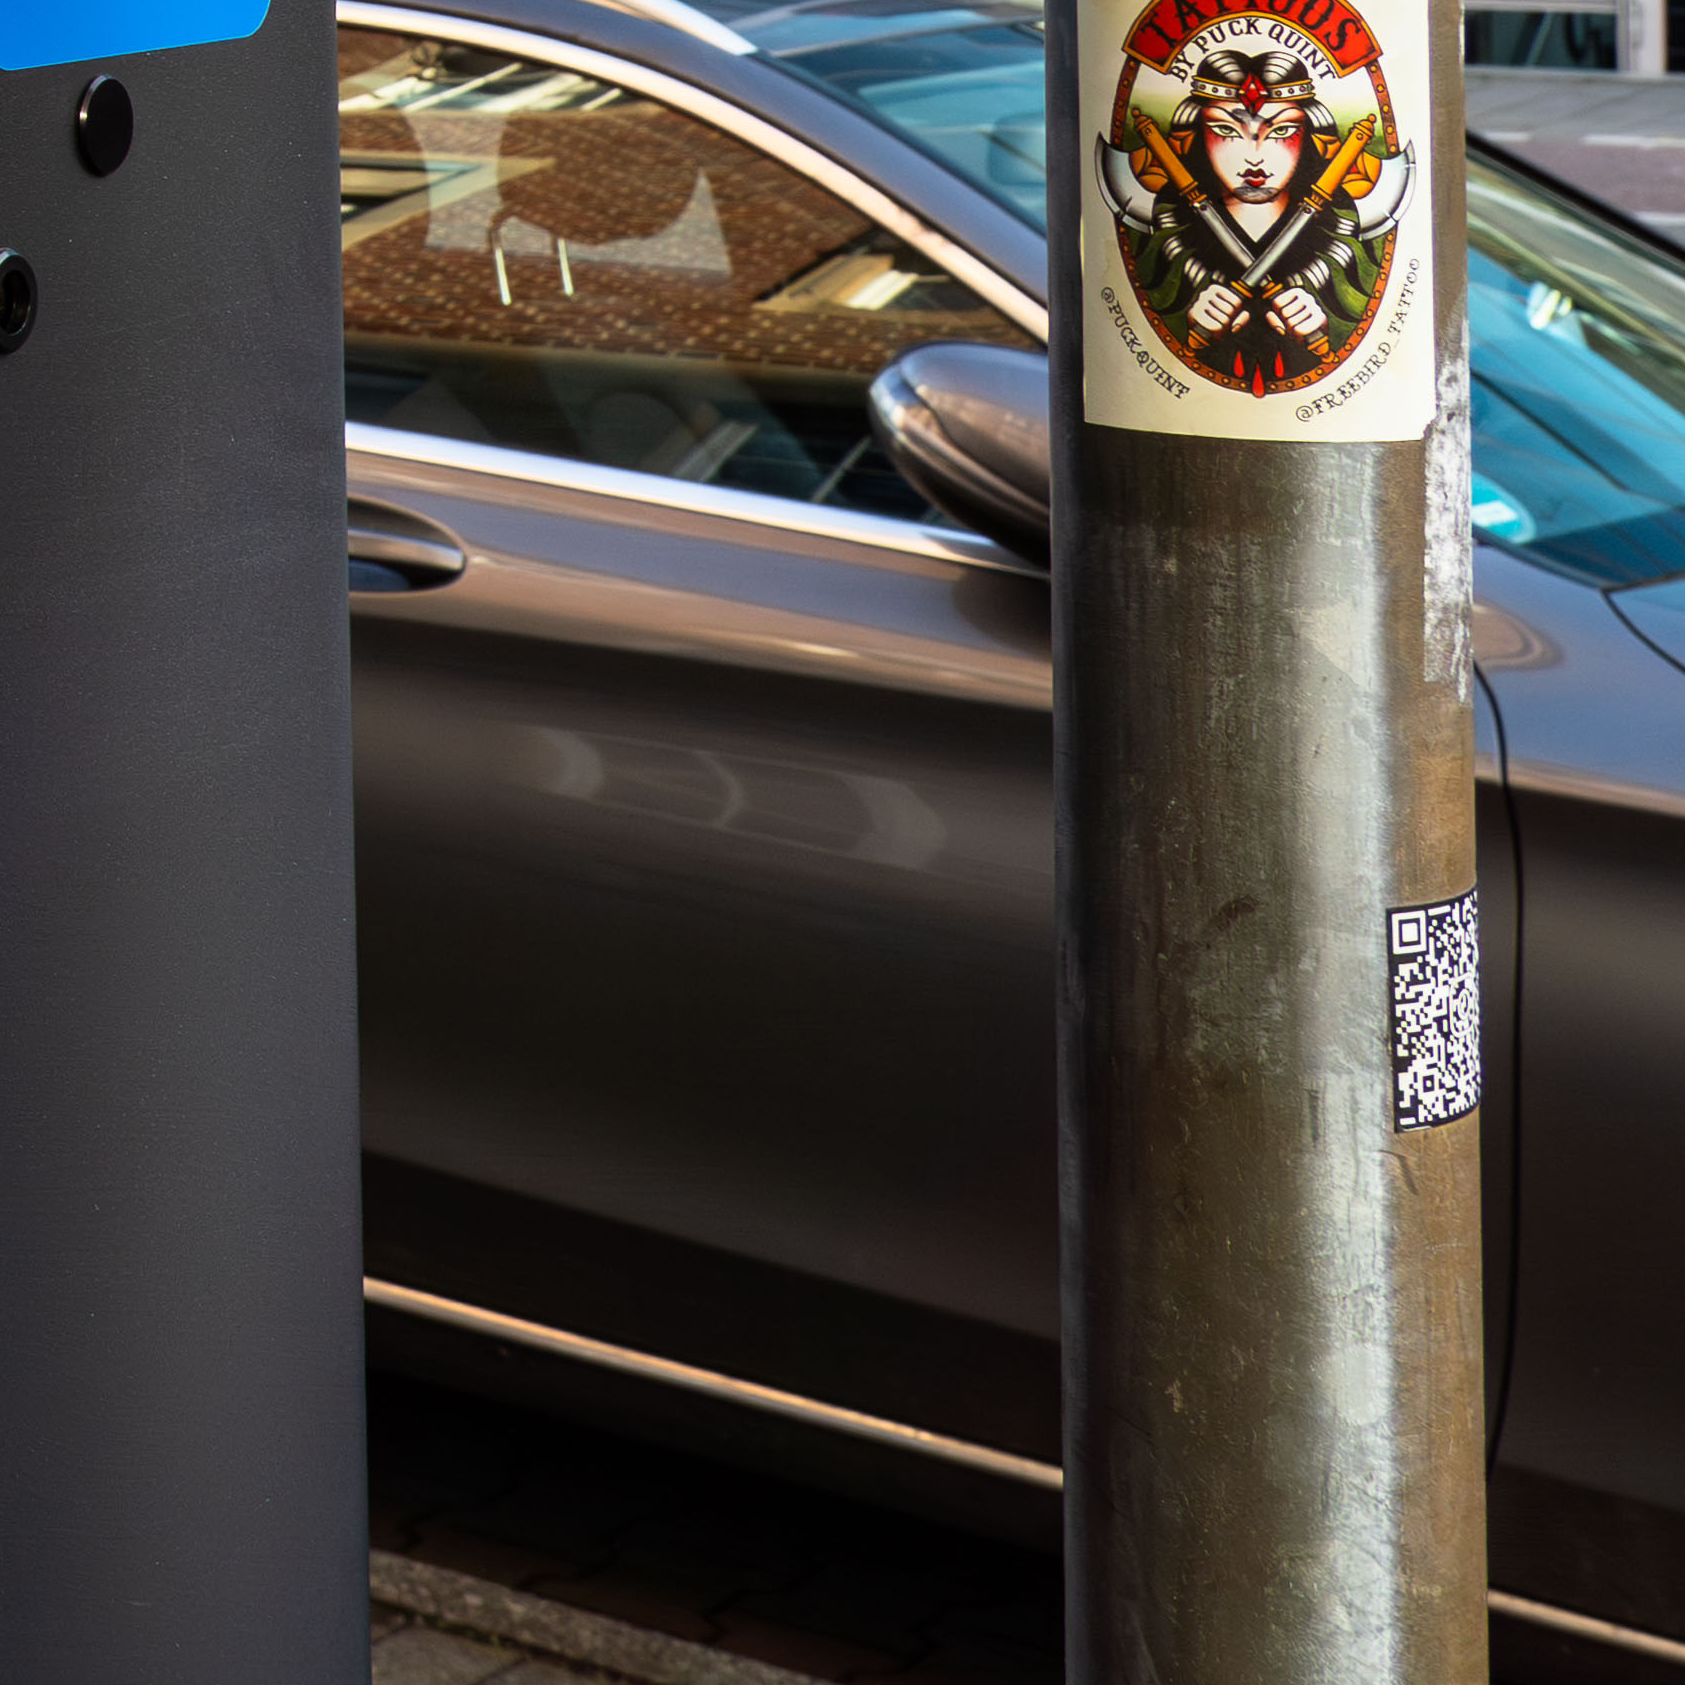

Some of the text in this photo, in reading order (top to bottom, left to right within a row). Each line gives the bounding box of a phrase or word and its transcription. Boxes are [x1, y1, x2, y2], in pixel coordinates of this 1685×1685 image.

[1169, 16, 1338, 84] BY PUCK QUINT
[1101, 286, 1190, 400] @PUCKQUINT
[1295, 258, 1421, 423] @FREEBIRD_TATTOO
